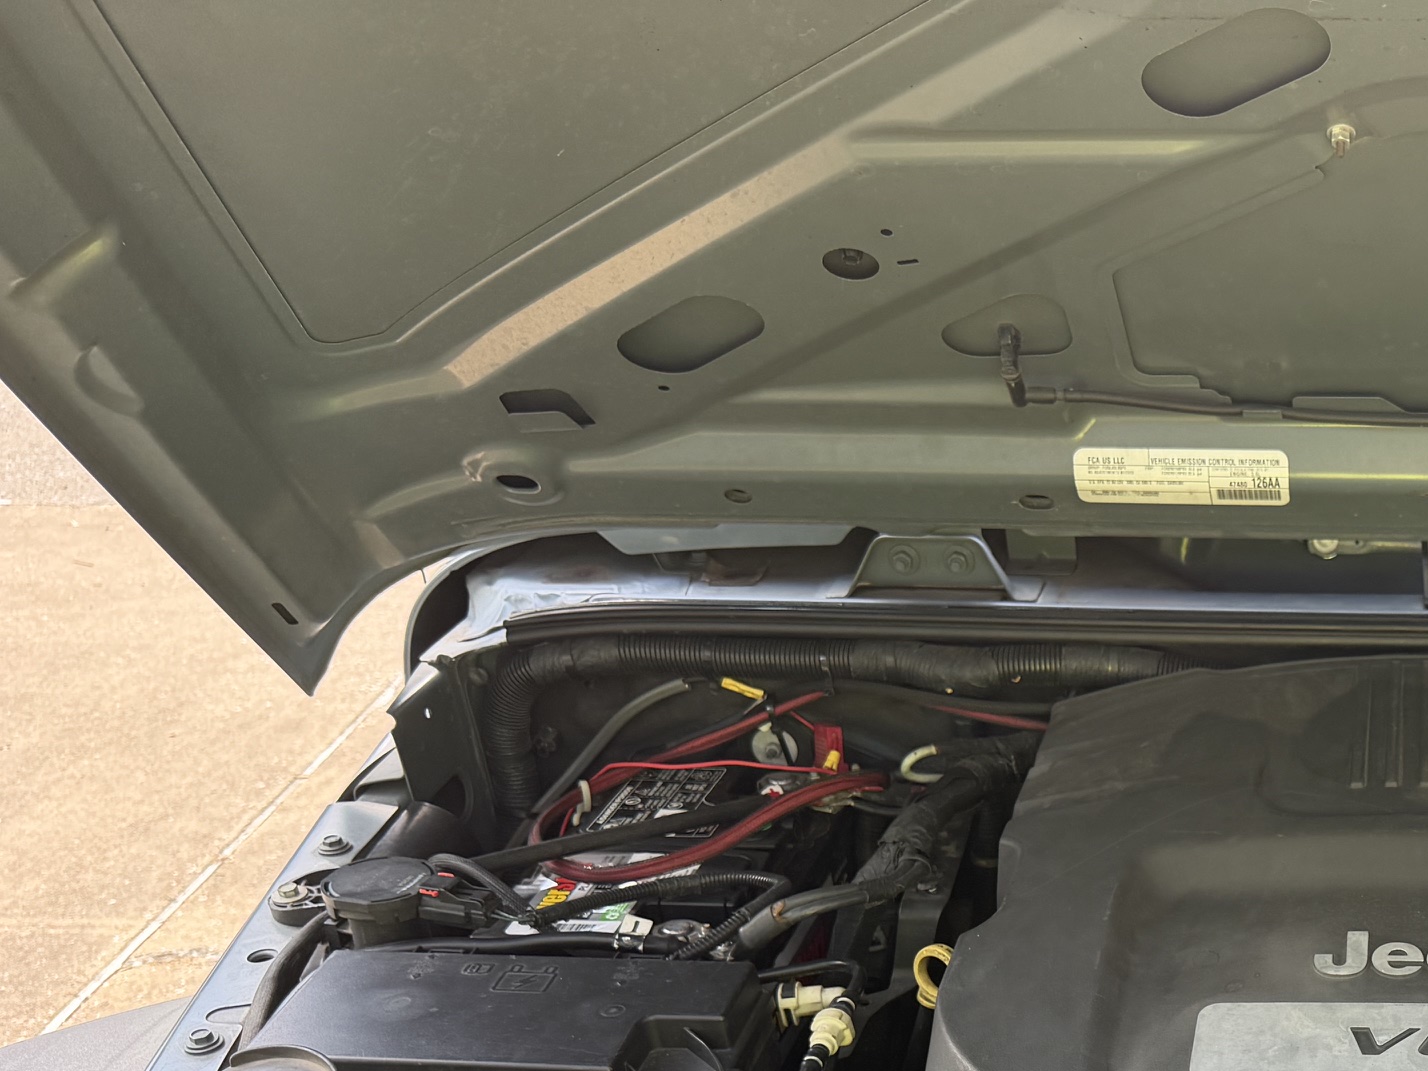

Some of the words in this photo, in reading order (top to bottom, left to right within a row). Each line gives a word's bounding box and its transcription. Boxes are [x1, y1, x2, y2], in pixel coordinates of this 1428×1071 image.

[1088, 457, 1099, 465] FCA
[1102, 457, 1110, 465] US
[1113, 457, 1125, 465] LLC
[1150, 458, 1175, 466] VEHICLE
[1177, 458, 1207, 466] EMISSION
[1238, 459, 1280, 467] INFORMATION
[1251, 477, 1281, 489] 126AA
